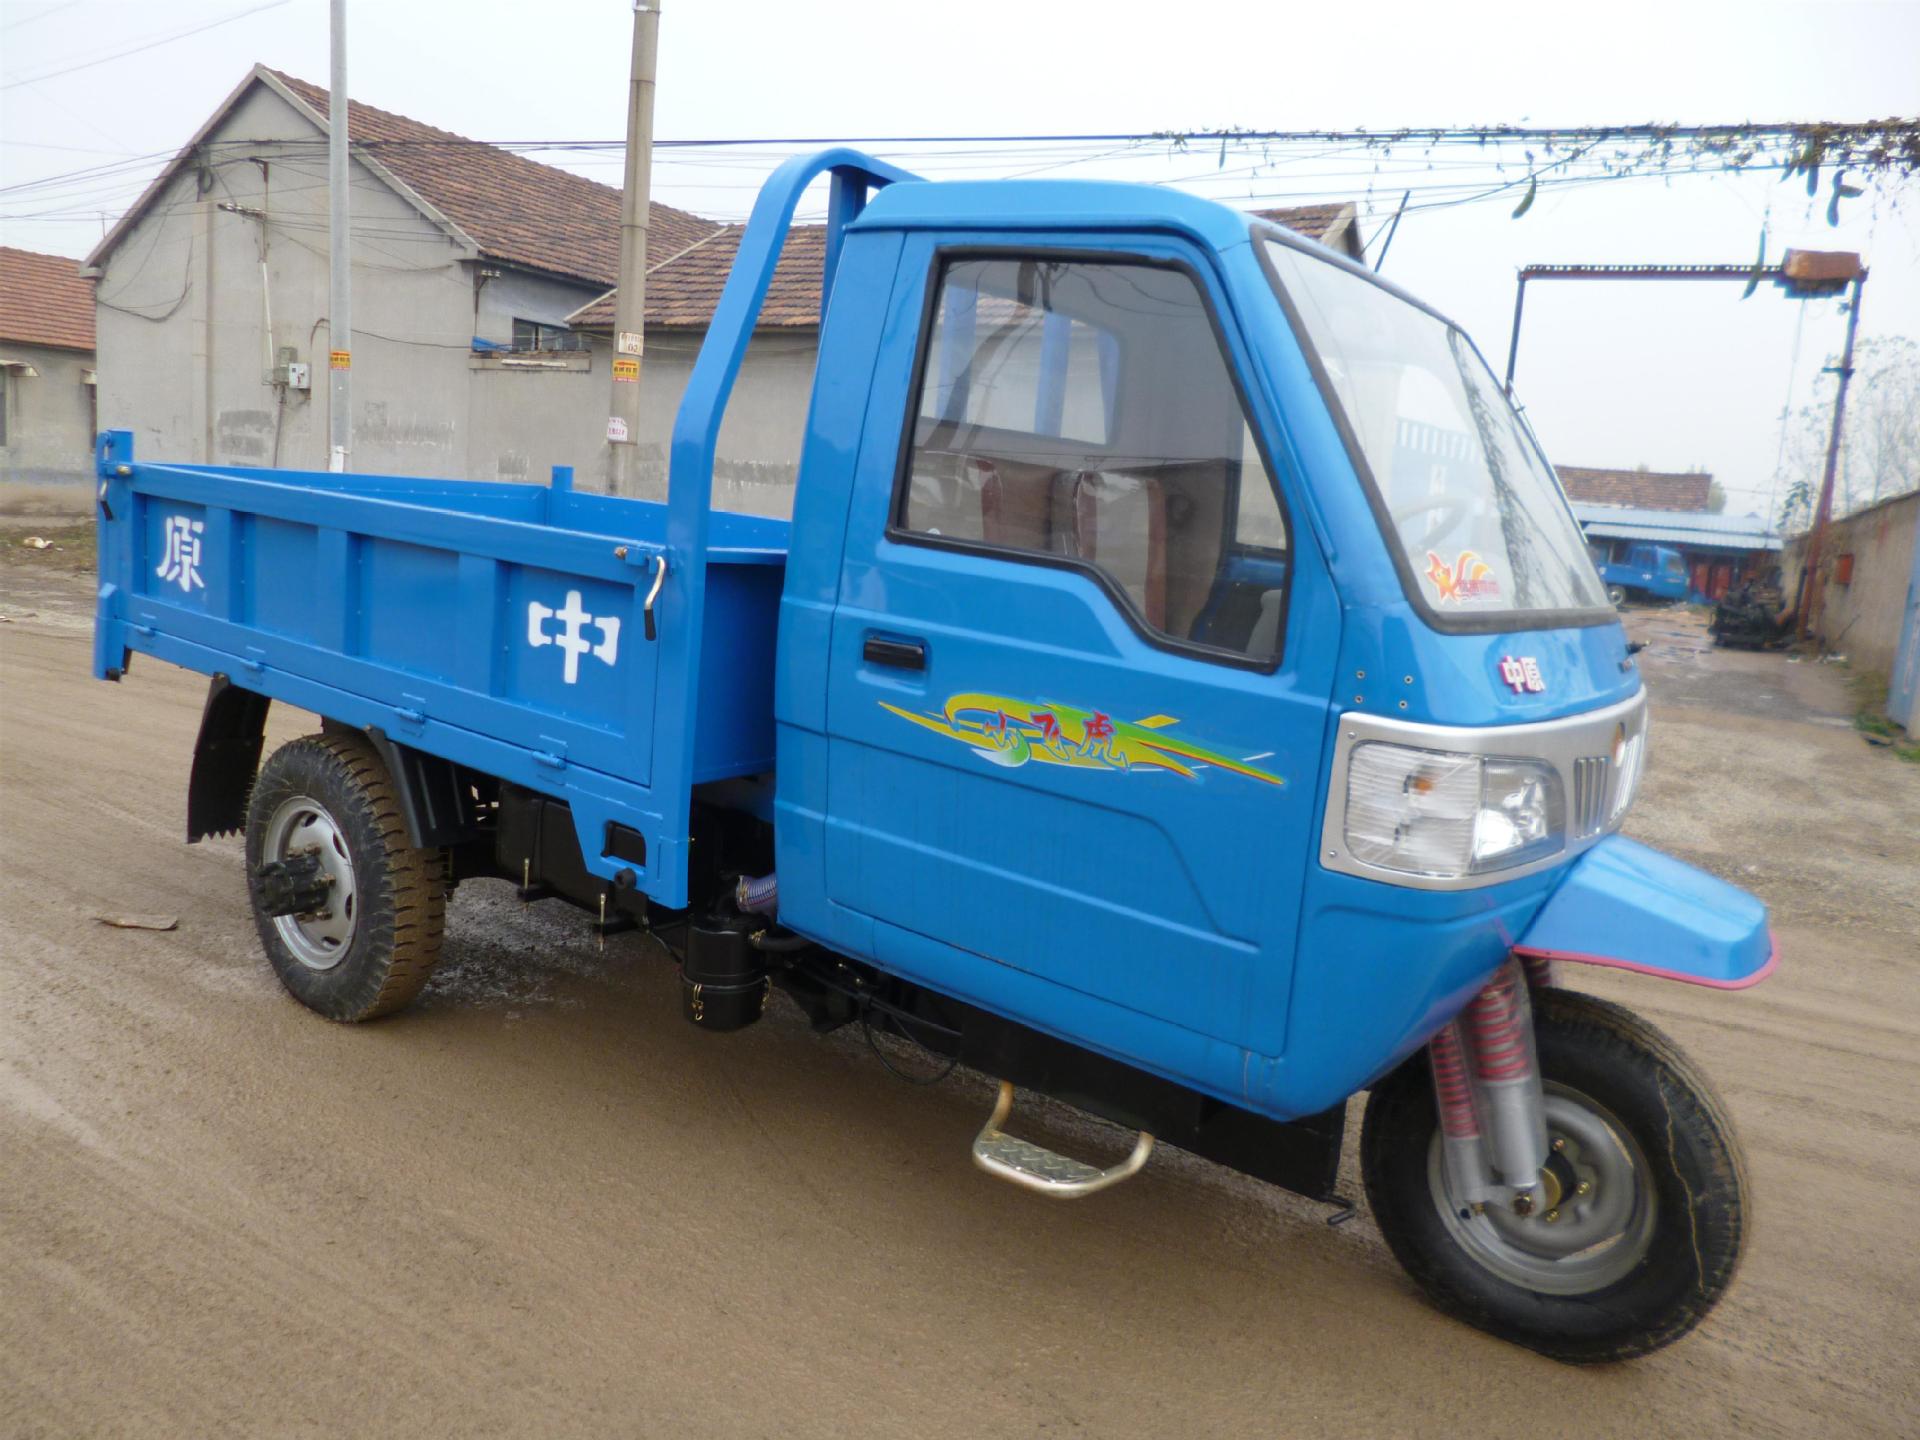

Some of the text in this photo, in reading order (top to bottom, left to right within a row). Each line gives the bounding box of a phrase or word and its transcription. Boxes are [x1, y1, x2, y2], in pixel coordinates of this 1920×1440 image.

[156, 515, 205, 593] 原
[528, 590, 621, 685] 中
[1498, 654, 1546, 695] 中原
